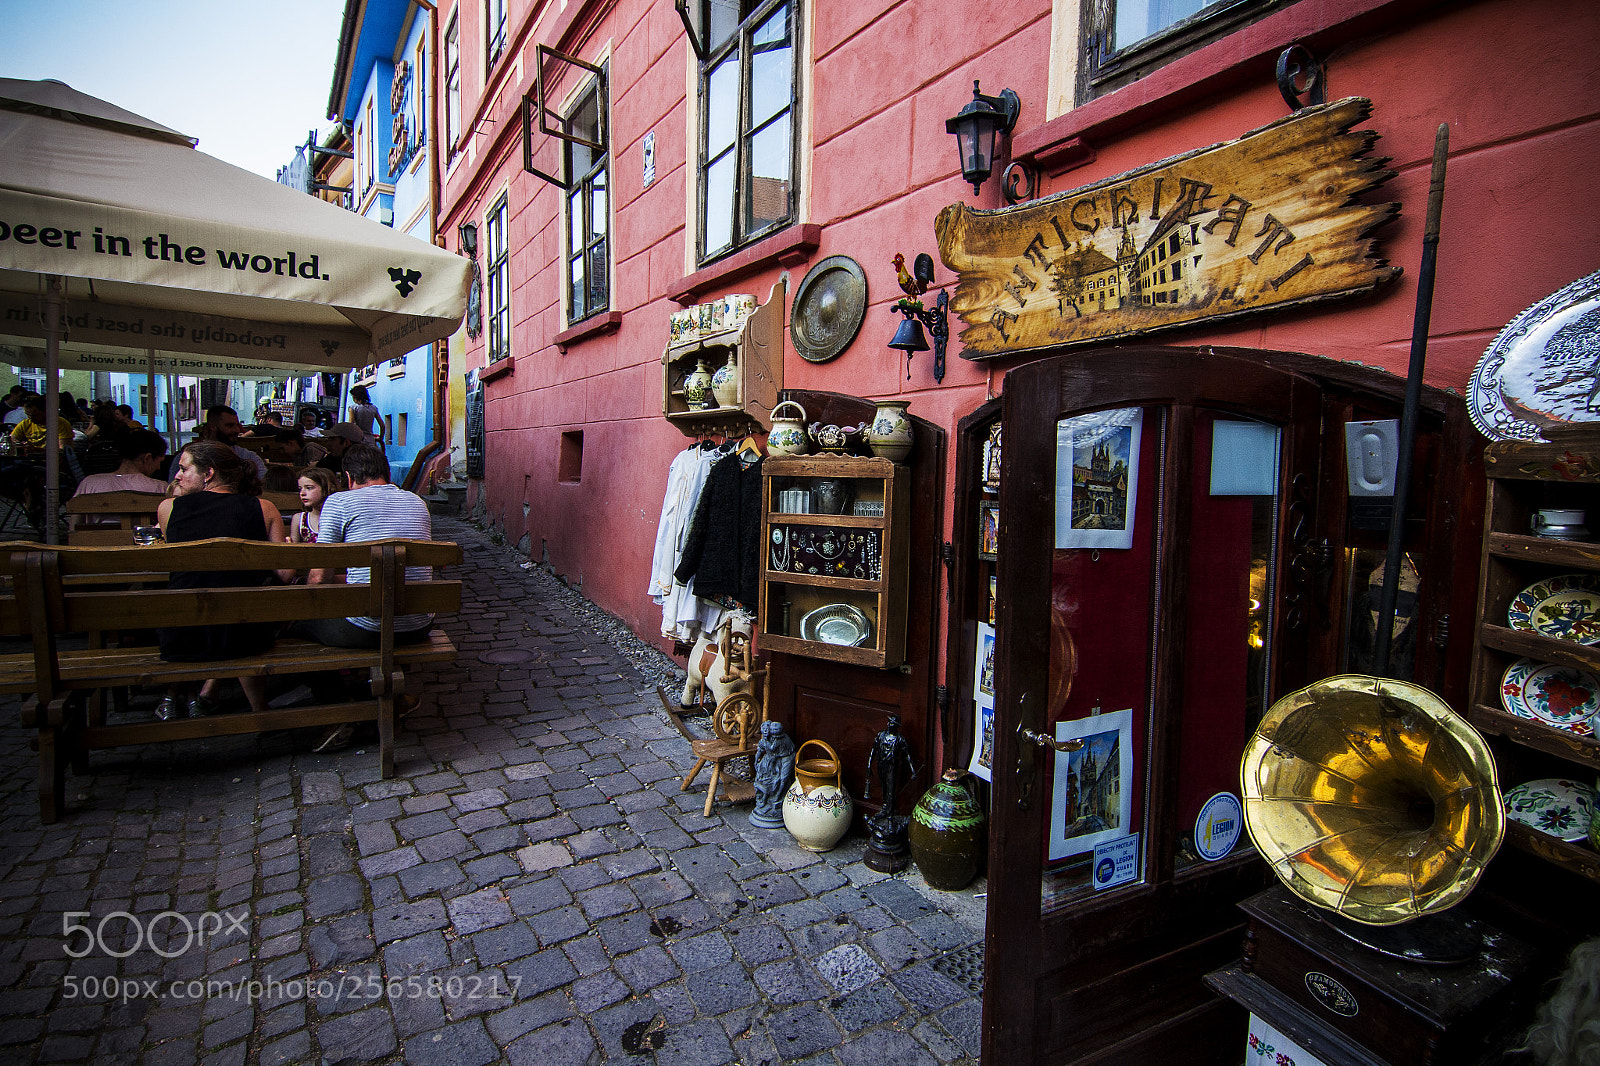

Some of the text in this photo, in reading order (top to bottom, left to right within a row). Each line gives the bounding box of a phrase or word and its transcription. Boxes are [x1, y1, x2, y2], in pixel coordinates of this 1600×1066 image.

[92, 227, 132, 257] in
[142, 233, 206, 266] the
[216, 250, 330, 281] world.
[1212, 819, 1235, 835] LEGION
[1116, 854, 1134, 864] LEGION
